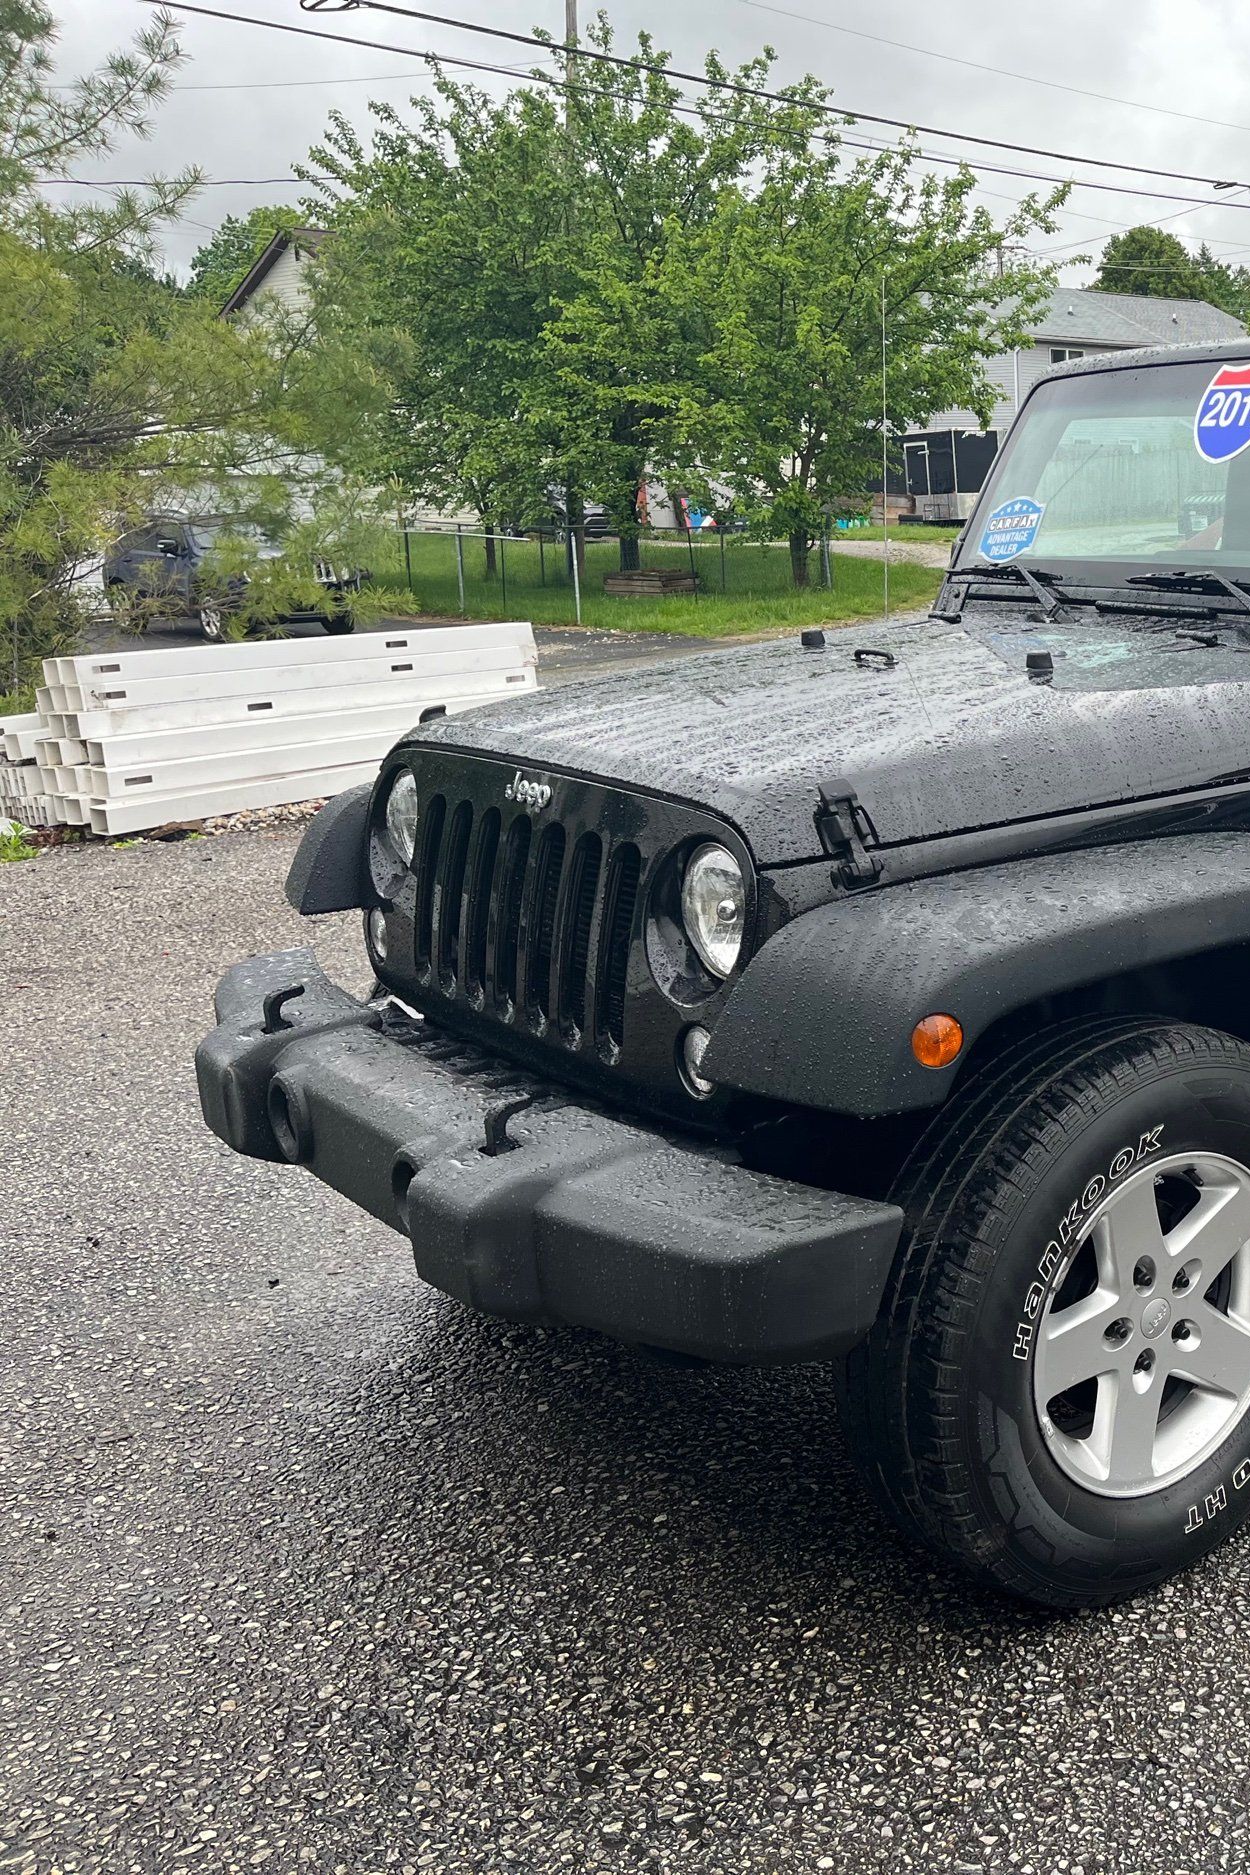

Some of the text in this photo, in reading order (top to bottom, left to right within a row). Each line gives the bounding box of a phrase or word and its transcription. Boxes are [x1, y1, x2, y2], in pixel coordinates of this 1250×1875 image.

[989, 514, 1038, 531] CARFAX
[987, 531, 1030, 545] ADVANTAGE
[990, 543, 1018, 556] DEALER
[504, 771, 551, 813] Jeep
[1184, 1485, 1228, 1534] HT
